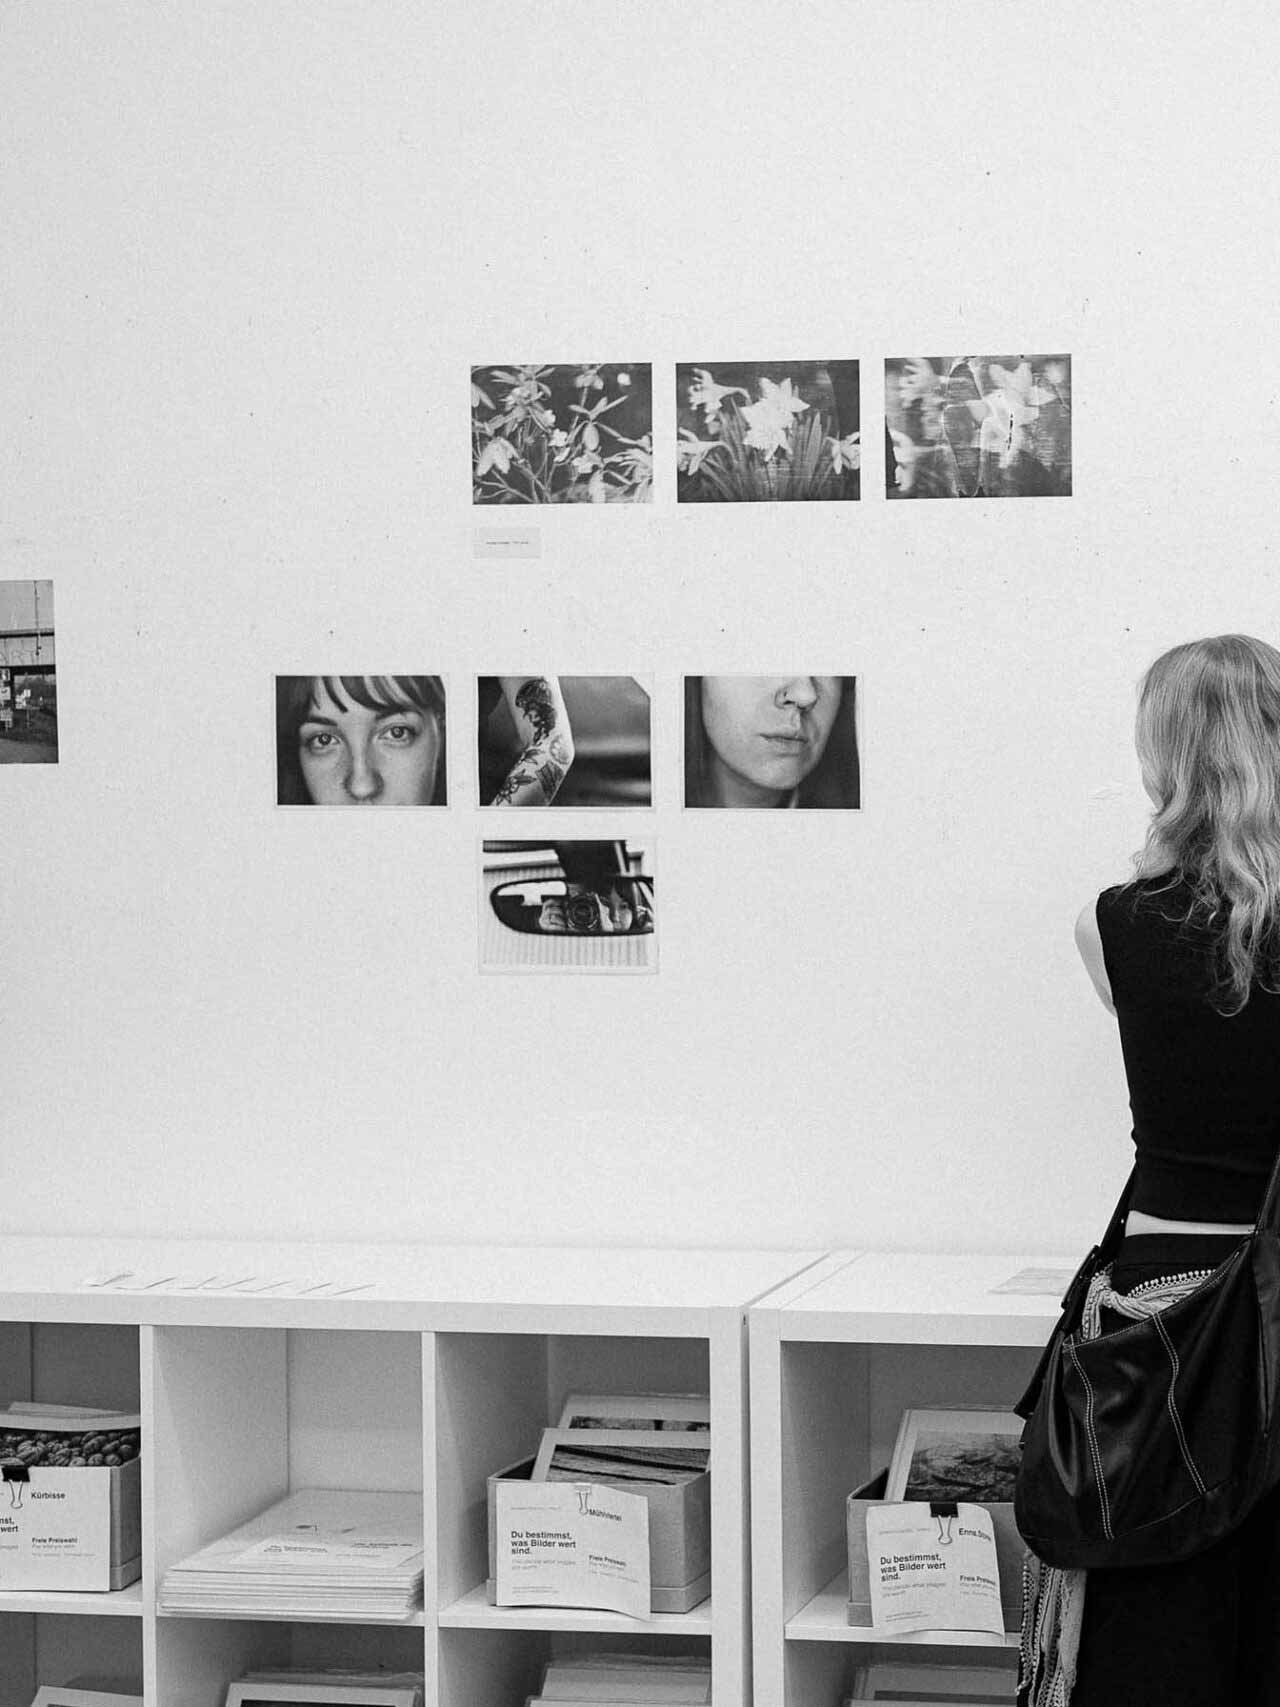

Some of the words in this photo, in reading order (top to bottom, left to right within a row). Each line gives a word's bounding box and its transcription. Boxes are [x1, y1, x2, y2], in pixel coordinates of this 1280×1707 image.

[511, 1530, 524, 1539] Du
[526, 1531, 572, 1540] bestimmst,
[531, 1539, 556, 1548] Bilder
[558, 1541, 577, 1549] wert
[880, 1556, 892, 1565] Du
[893, 1554, 942, 1563] bestimmst,
[899, 1562, 925, 1571] Bilder
[927, 1562, 946, 1570] wert
